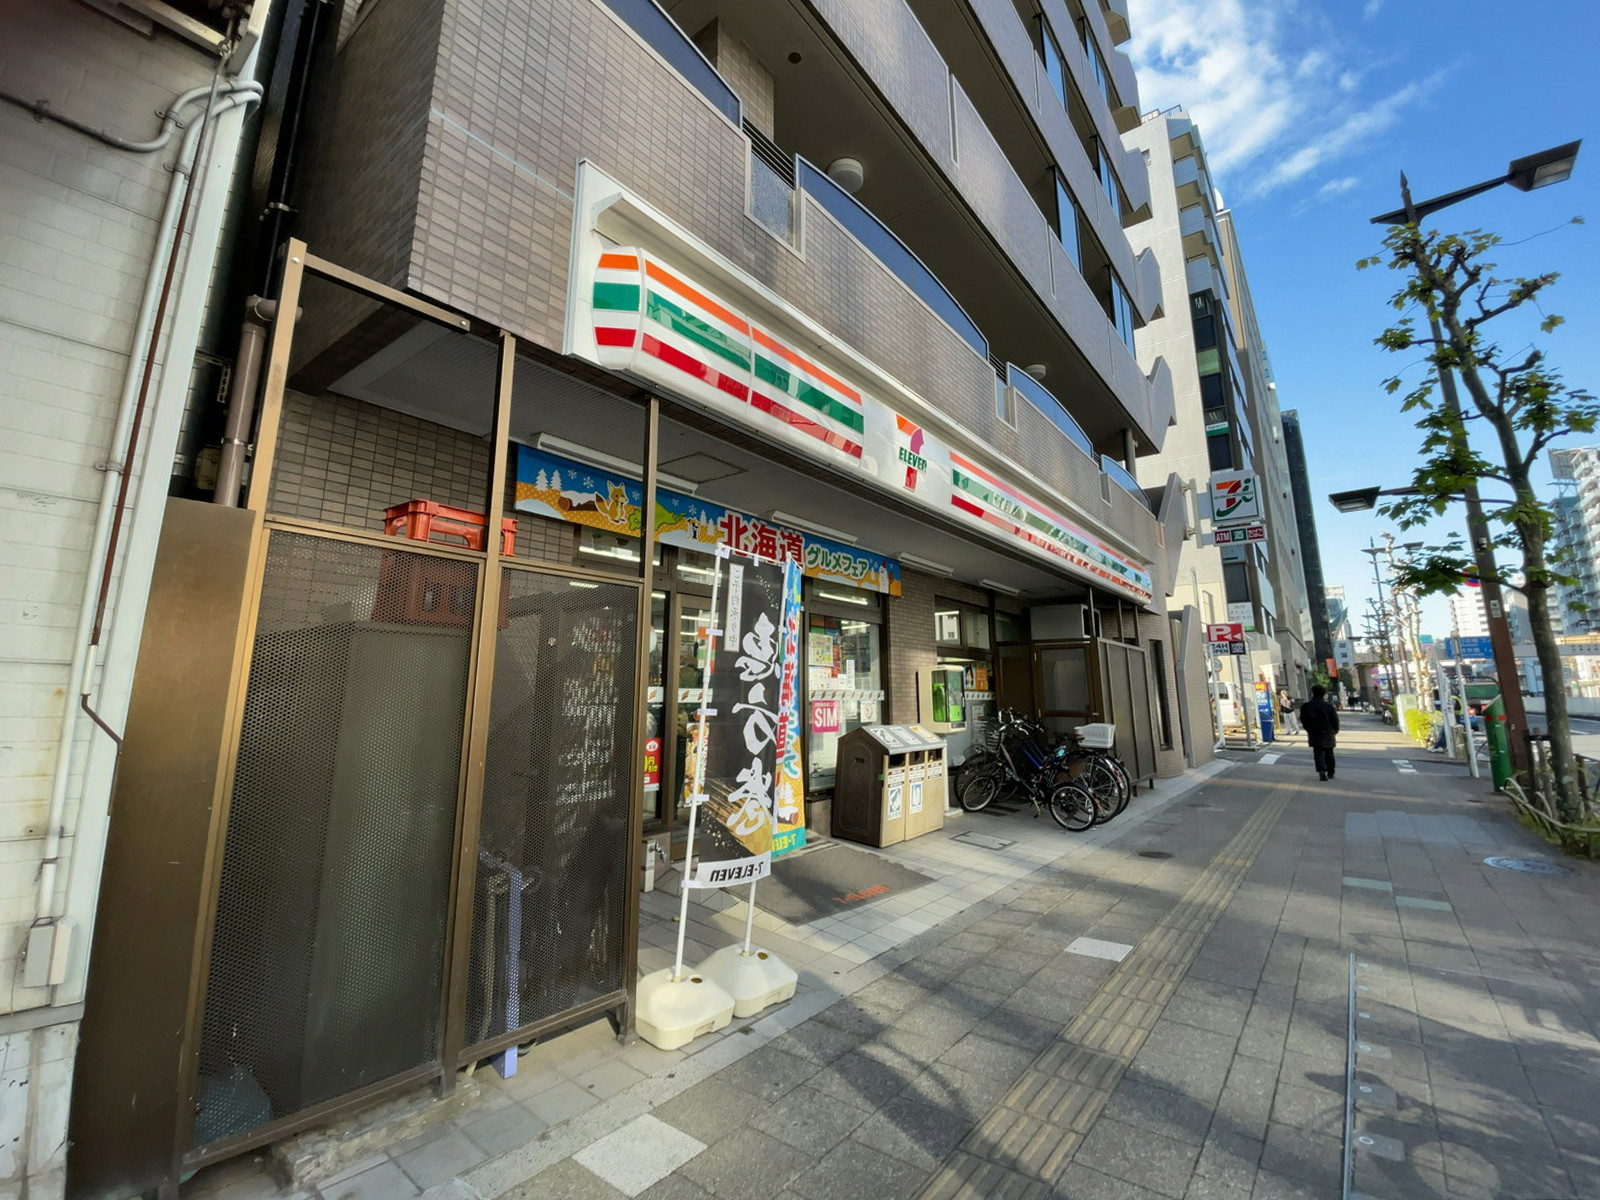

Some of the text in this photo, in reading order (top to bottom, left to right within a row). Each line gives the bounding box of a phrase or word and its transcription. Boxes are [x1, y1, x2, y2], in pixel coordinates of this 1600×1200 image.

[1216, 532, 1230, 542] ATM
[720, 513, 869, 579] 北海道 グルメフェア
[1209, 626, 1232, 641] P
[814, 708, 838, 727] SIM
